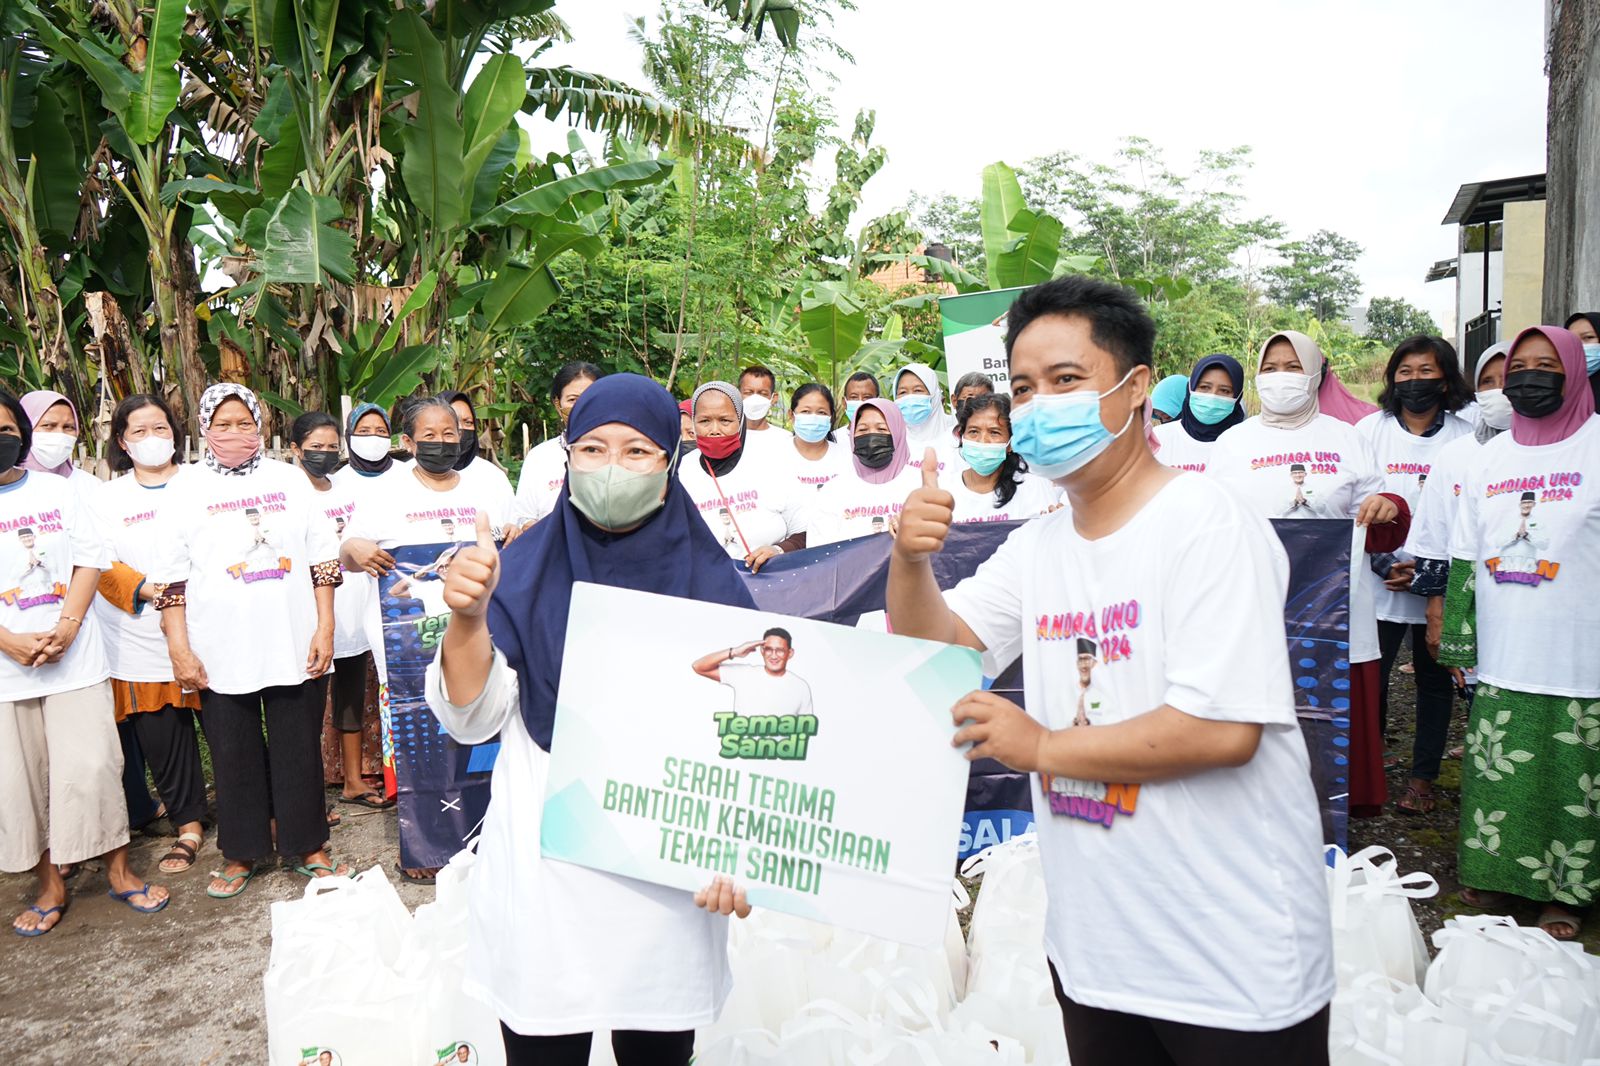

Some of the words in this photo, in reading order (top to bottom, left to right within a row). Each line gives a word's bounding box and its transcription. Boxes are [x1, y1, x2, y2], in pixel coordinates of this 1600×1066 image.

[1251, 451, 1312, 470] SANDIAGA
[1315, 451, 1341, 463] UNO
[1310, 463, 1338, 474] 2024
[1548, 472, 1583, 487] UNO
[207, 496, 262, 516] SANDIAGA
[263, 491, 287, 504] UNO
[737, 490, 758, 502] UNO
[1540, 488, 1574, 502] 2024
[38, 508, 62, 523] UNO
[262, 504, 287, 515] 2024
[406, 508, 456, 523] SANDIAGA
[457, 507, 477, 517] UNO
[735, 501, 757, 514] 2024
[37, 521, 63, 535] 2024
[1102, 599, 1139, 634] UNO
[1100, 634, 1133, 664] 024
[713, 711, 818, 737] Teman
[719, 733, 809, 760] Sandi
[662, 756, 740, 801] SERAH
[749, 772, 836, 823] TERIMA
[603, 779, 710, 831] BANTUAN
[717, 804, 891, 874] KEMANUSIAAN
[659, 827, 739, 876] TEMAN
[746, 846, 822, 895] SANDI
